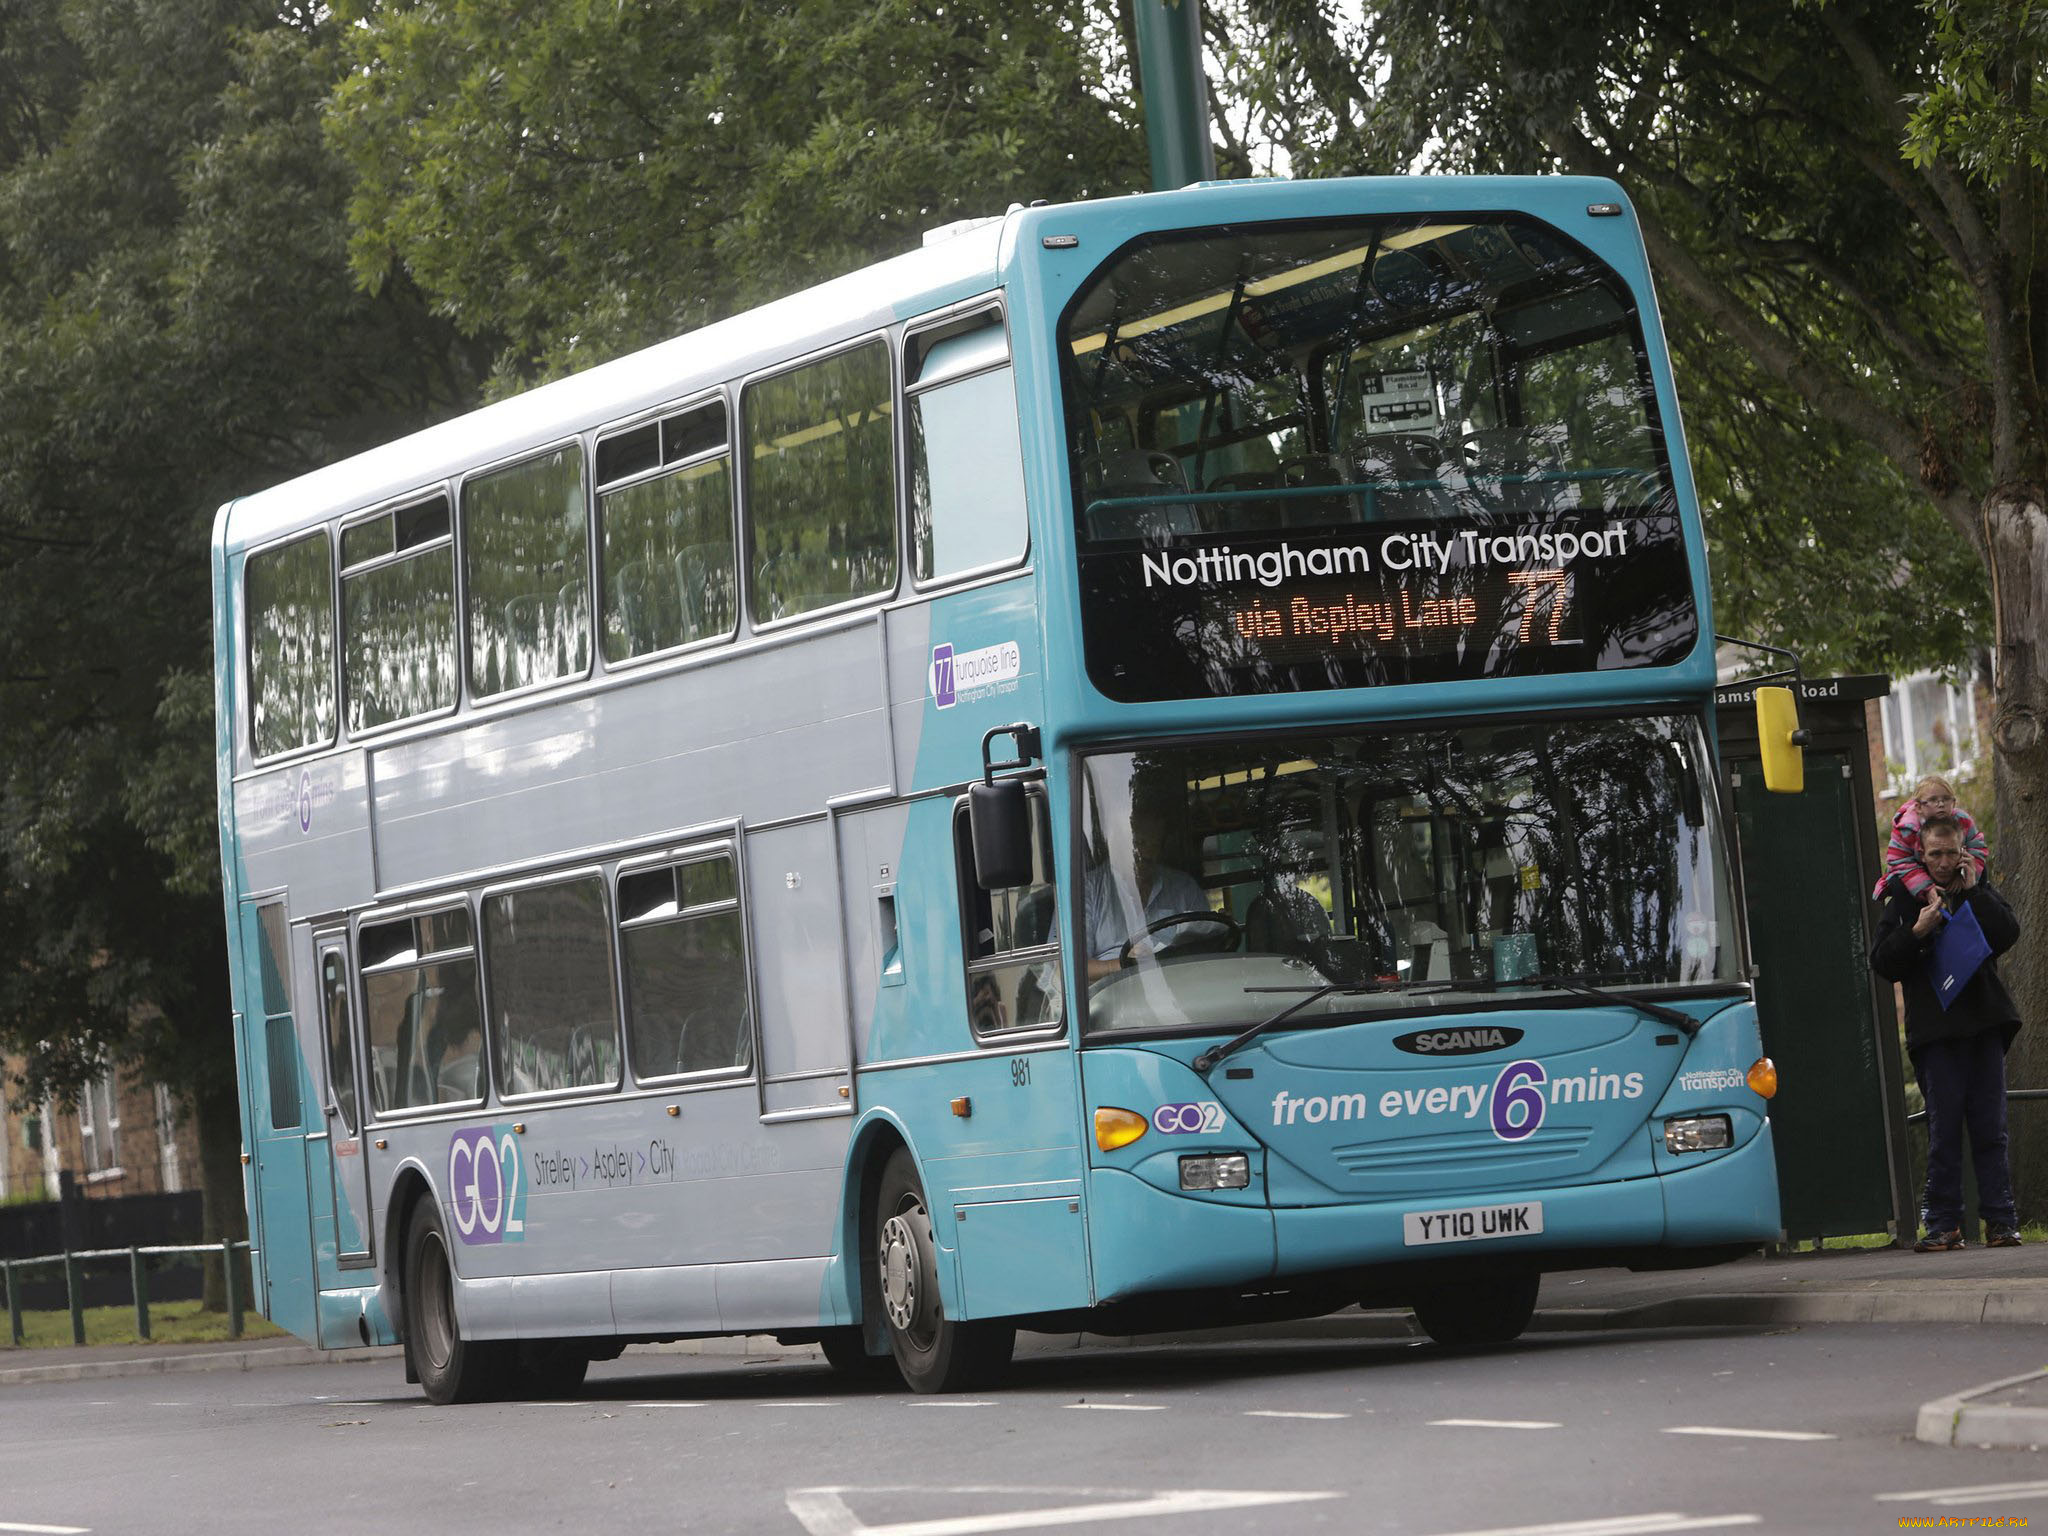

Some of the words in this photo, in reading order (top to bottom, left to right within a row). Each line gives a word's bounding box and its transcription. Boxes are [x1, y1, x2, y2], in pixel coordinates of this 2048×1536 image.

[1142, 543, 1370, 587] Nottingham
[1381, 532, 1453, 574] City
[1460, 522, 1627, 567] Transport
[1236, 599, 1282, 638] via
[1291, 594, 1394, 644] Aspley
[1401, 590, 1477, 628] Lane
[1508, 569, 1565, 643] 77
[955, 652, 998, 682] turquoise
[1001, 646, 1017, 669] line
[298, 769, 312, 834] 6
[1416, 1029, 1506, 1052] SCANIA
[1011, 1058, 1031, 1087] 981
[1679, 1072, 1744, 1091] Transport
[1685, 1069, 1727, 1079] Nottingham
[1154, 1103, 1221, 1133] GO2
[1272, 1091, 1366, 1126] from
[1379, 1084, 1488, 1118] every
[1490, 1060, 1547, 1141] 6
[1551, 1067, 1644, 1104] mins
[450, 1132, 524, 1236] GO2
[534, 1150, 576, 1190] Strelley
[594, 1144, 633, 1187] Aspley
[649, 1139, 675, 1182] City
[1419, 1212, 1474, 1239] YT10
[1482, 1207, 1529, 1233] UWK
